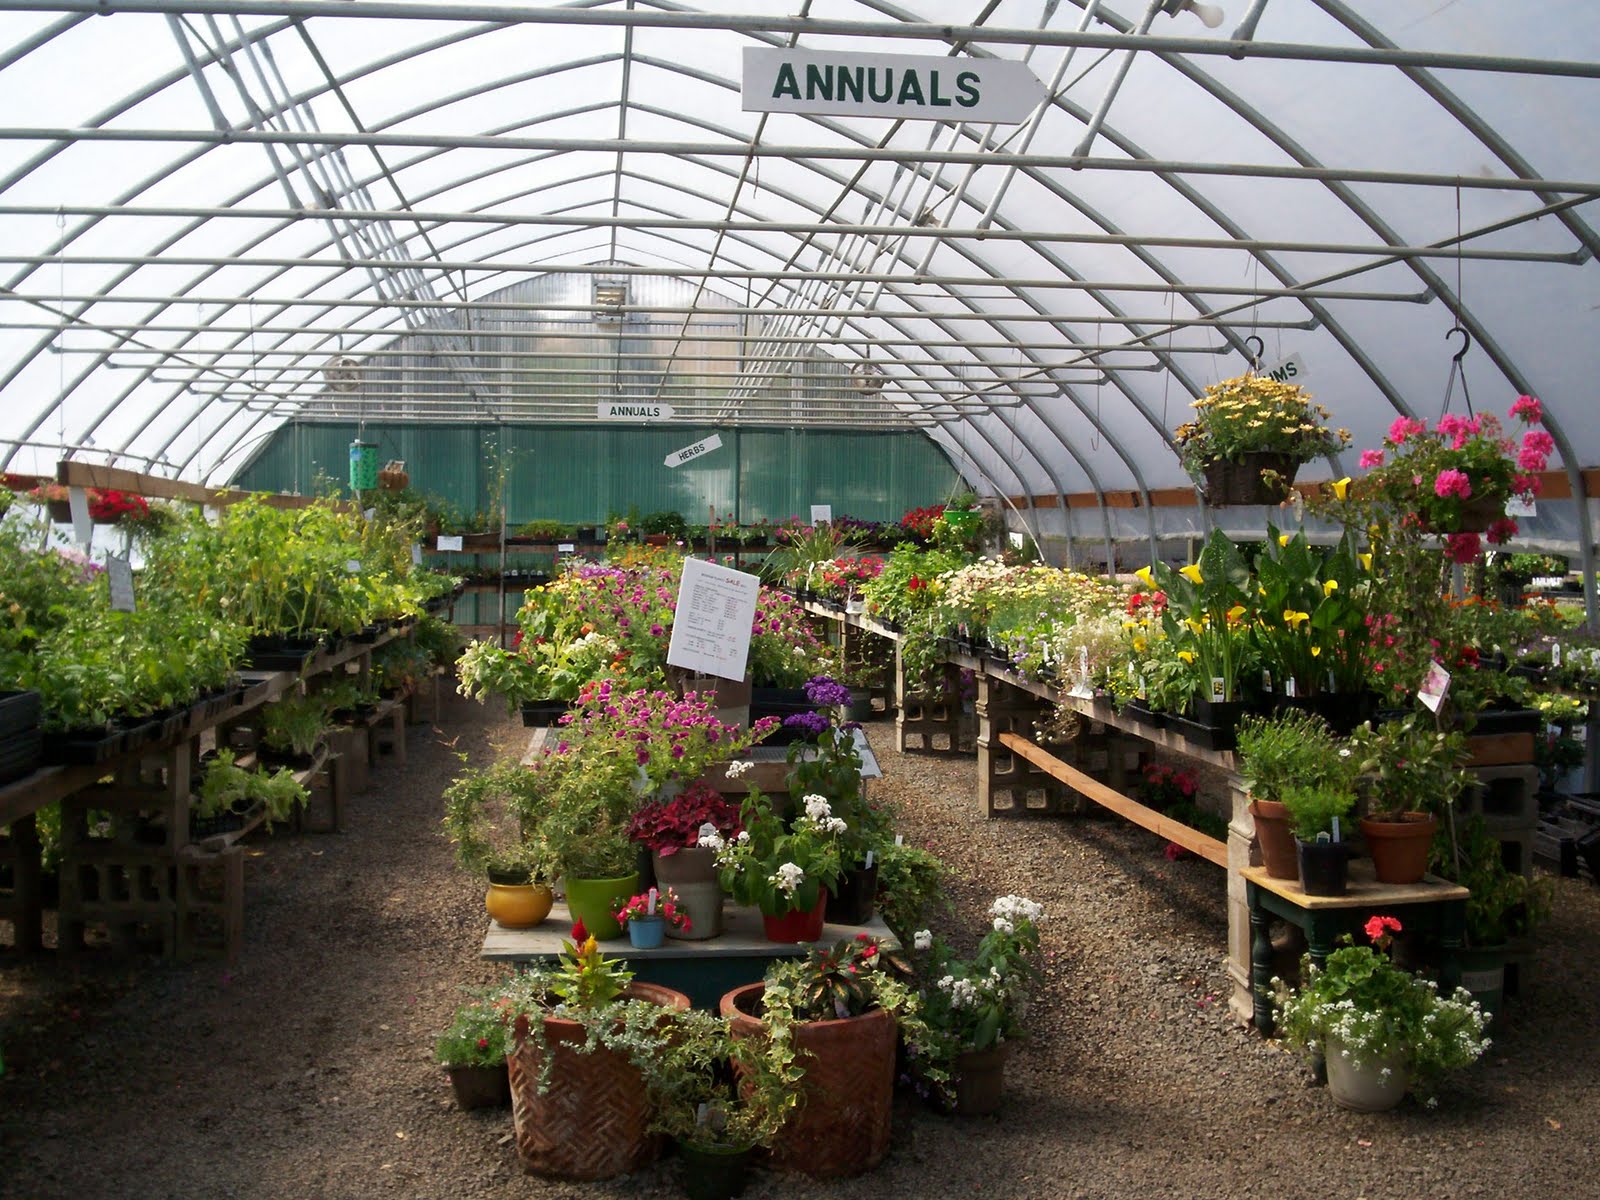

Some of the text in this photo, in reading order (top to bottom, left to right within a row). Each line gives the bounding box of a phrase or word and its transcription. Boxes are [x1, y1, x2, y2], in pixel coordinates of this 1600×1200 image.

[772, 62, 981, 108] ANNUALS
[610, 406, 660, 417] ANNUALS
[678, 443, 706, 461] HERBS
[725, 577, 741, 587] SALE
